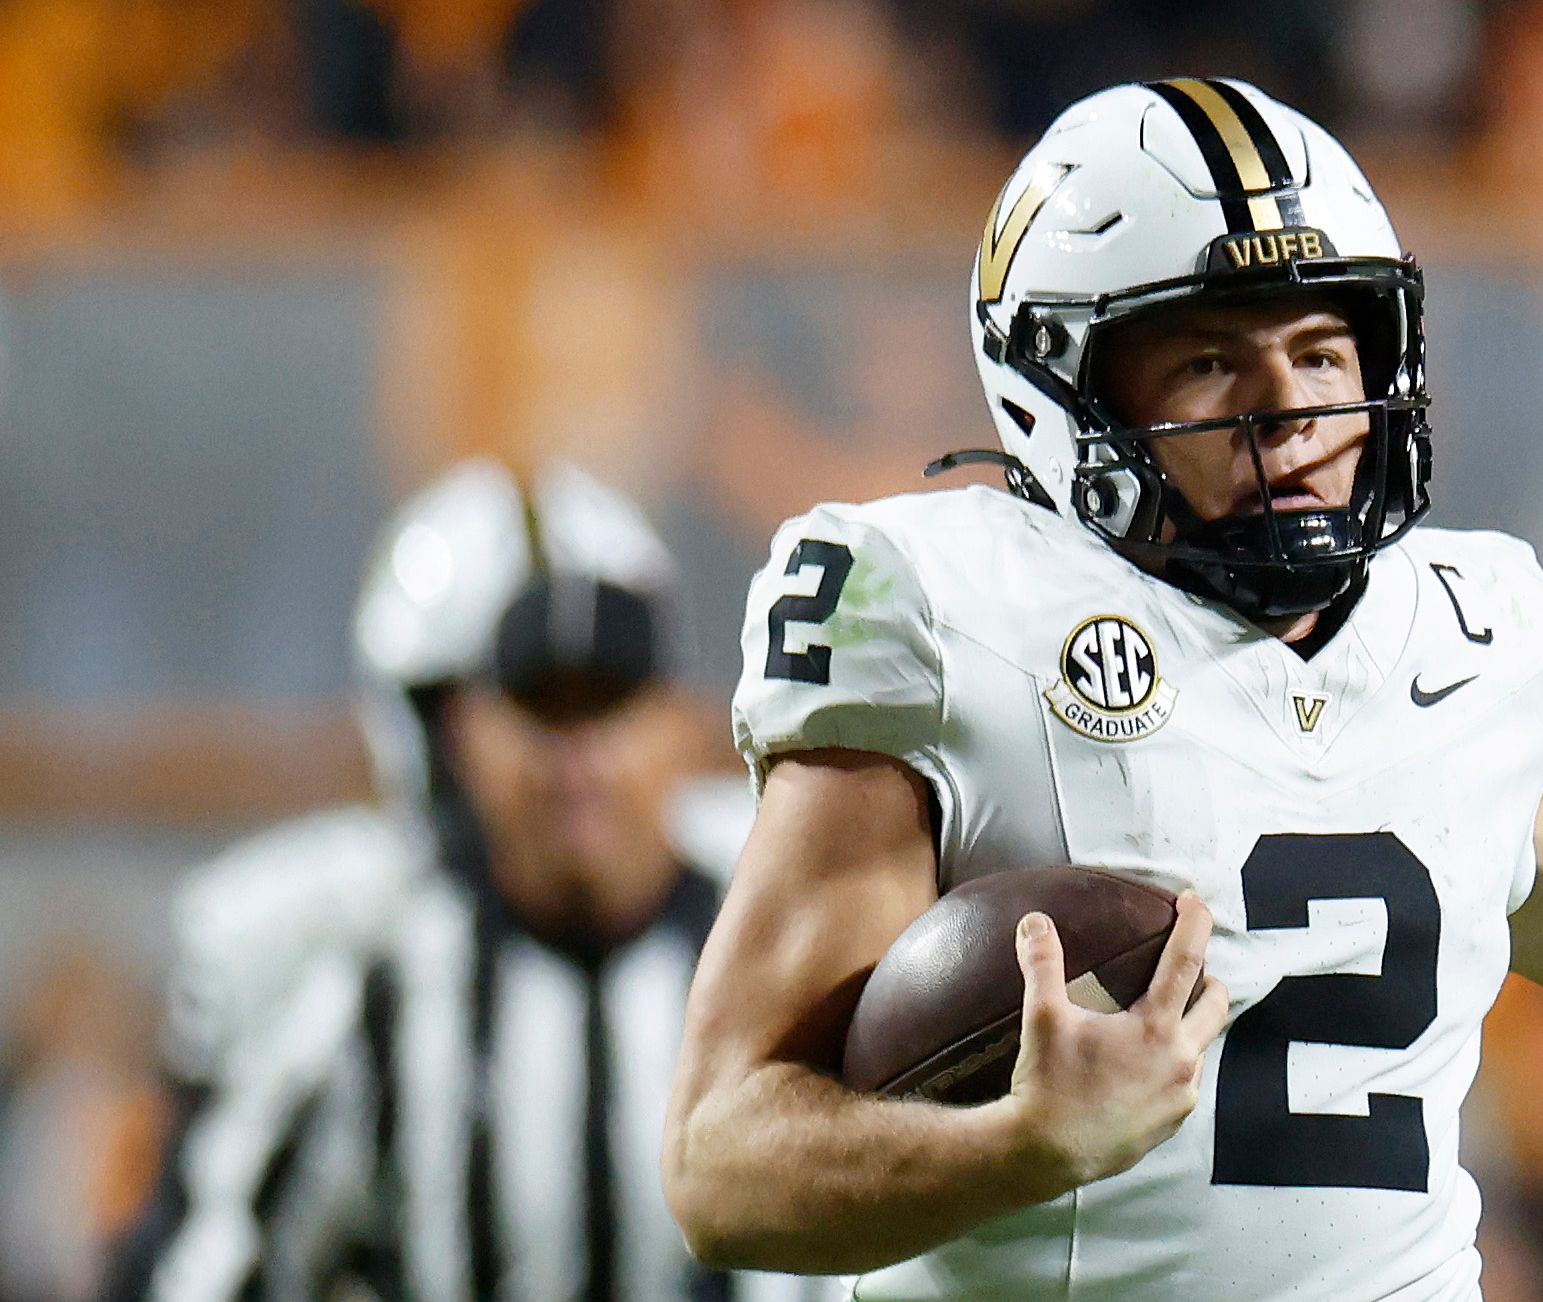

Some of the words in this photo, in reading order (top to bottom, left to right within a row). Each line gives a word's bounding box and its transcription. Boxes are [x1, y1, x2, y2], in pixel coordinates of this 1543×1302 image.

[977, 163, 1081, 303] V
[1223, 232, 1323, 269] VUFB
[764, 538, 855, 685] 2
[1429, 562, 1493, 646] C
[1070, 620, 1153, 708] SEC
[1064, 703, 1167, 737] GRADUATE
[1293, 696, 1327, 733] V
[1211, 832, 1441, 1193] 2
